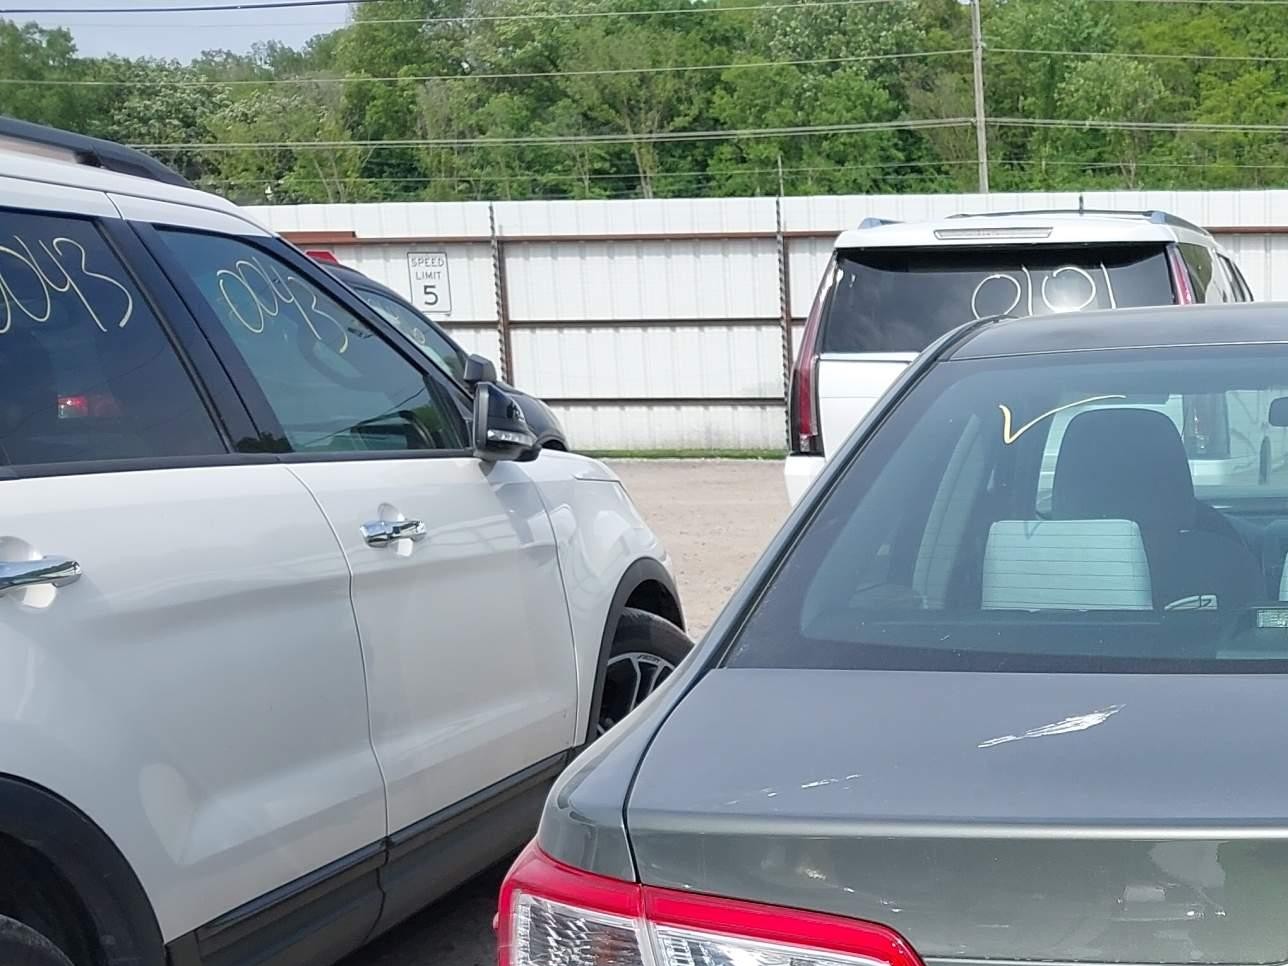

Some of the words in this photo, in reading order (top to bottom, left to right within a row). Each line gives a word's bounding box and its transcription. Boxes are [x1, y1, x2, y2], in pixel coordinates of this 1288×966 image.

[411, 256, 445, 267] SPEED
[0, 234, 133, 334] 043
[415, 271, 441, 281] LIMIT
[423, 284, 439, 306] 5
